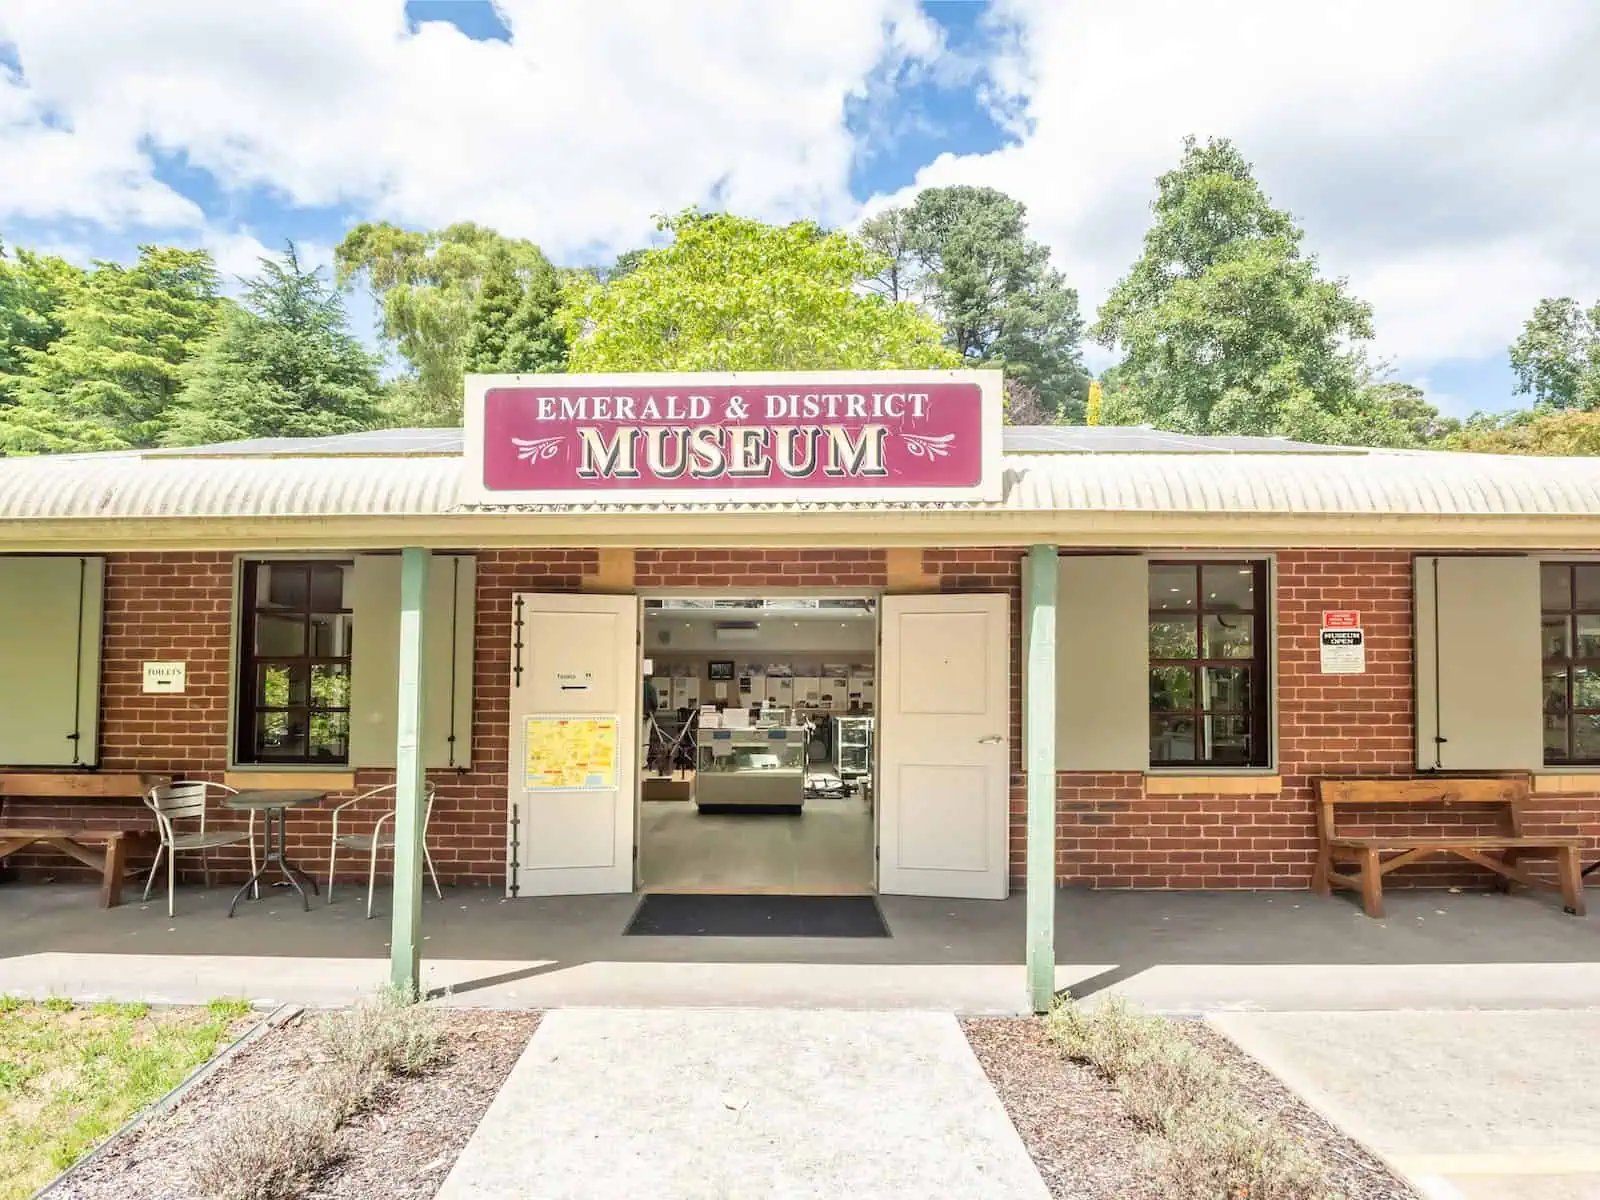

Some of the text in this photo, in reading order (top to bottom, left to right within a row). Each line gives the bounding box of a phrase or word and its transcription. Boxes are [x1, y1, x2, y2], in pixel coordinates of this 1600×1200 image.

[536, 393, 929, 420] EMERALD & DISTRICT
[575, 424, 889, 479] MUSEUM
[148, 667, 182, 677] TOILETS
